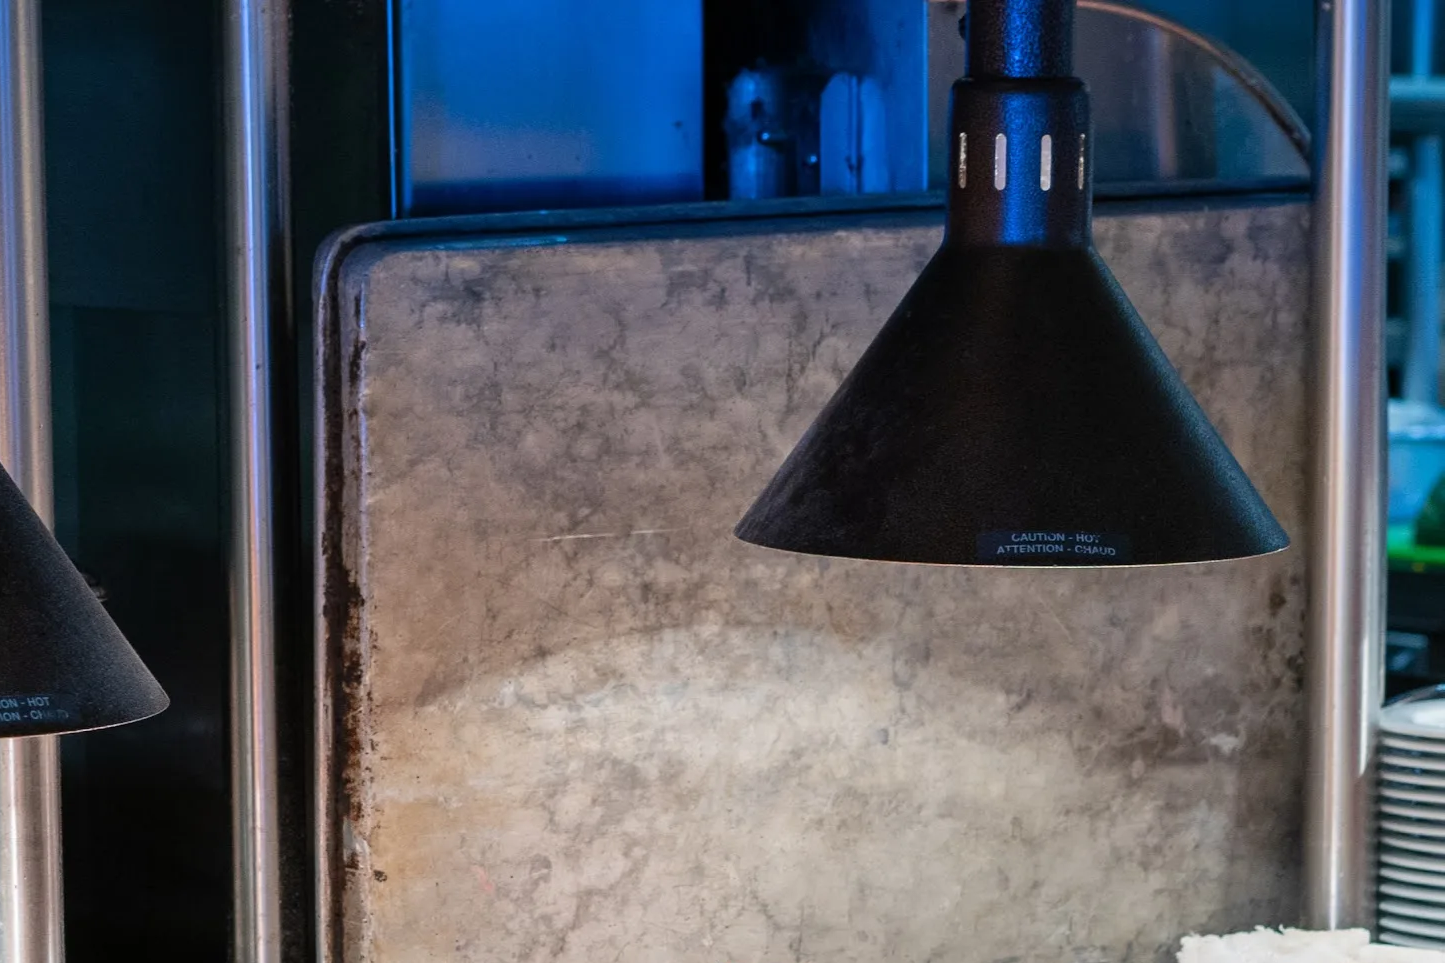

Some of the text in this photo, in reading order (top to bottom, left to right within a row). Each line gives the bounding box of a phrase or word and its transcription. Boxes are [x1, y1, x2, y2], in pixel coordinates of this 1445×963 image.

[1011, 533, 1065, 542] CAUTION
[996, 544, 1064, 554] ATTENTION
[1074, 545, 1116, 556] CHAUD
[27, 696, 50, 707] HOT
